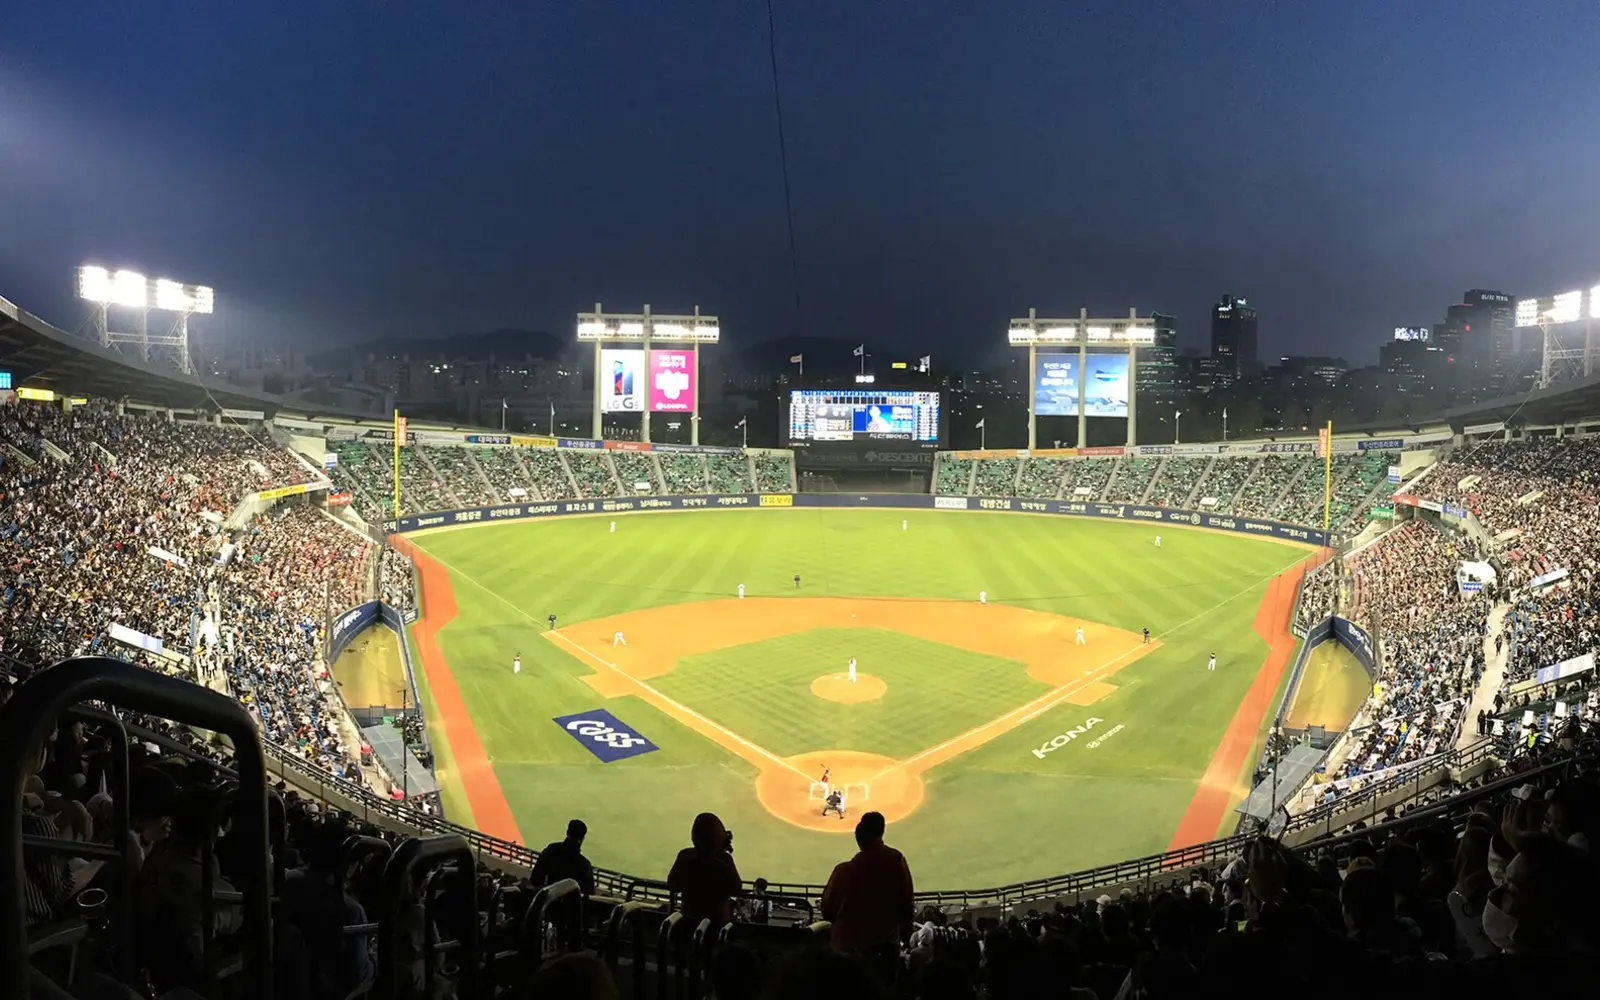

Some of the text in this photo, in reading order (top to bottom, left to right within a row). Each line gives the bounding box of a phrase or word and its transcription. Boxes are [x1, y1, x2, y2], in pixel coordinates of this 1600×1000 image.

[878, 452, 931, 463] DESCENTE
[980, 499, 1011, 509] 대방건설
[1032, 716, 1104, 760] KONA
